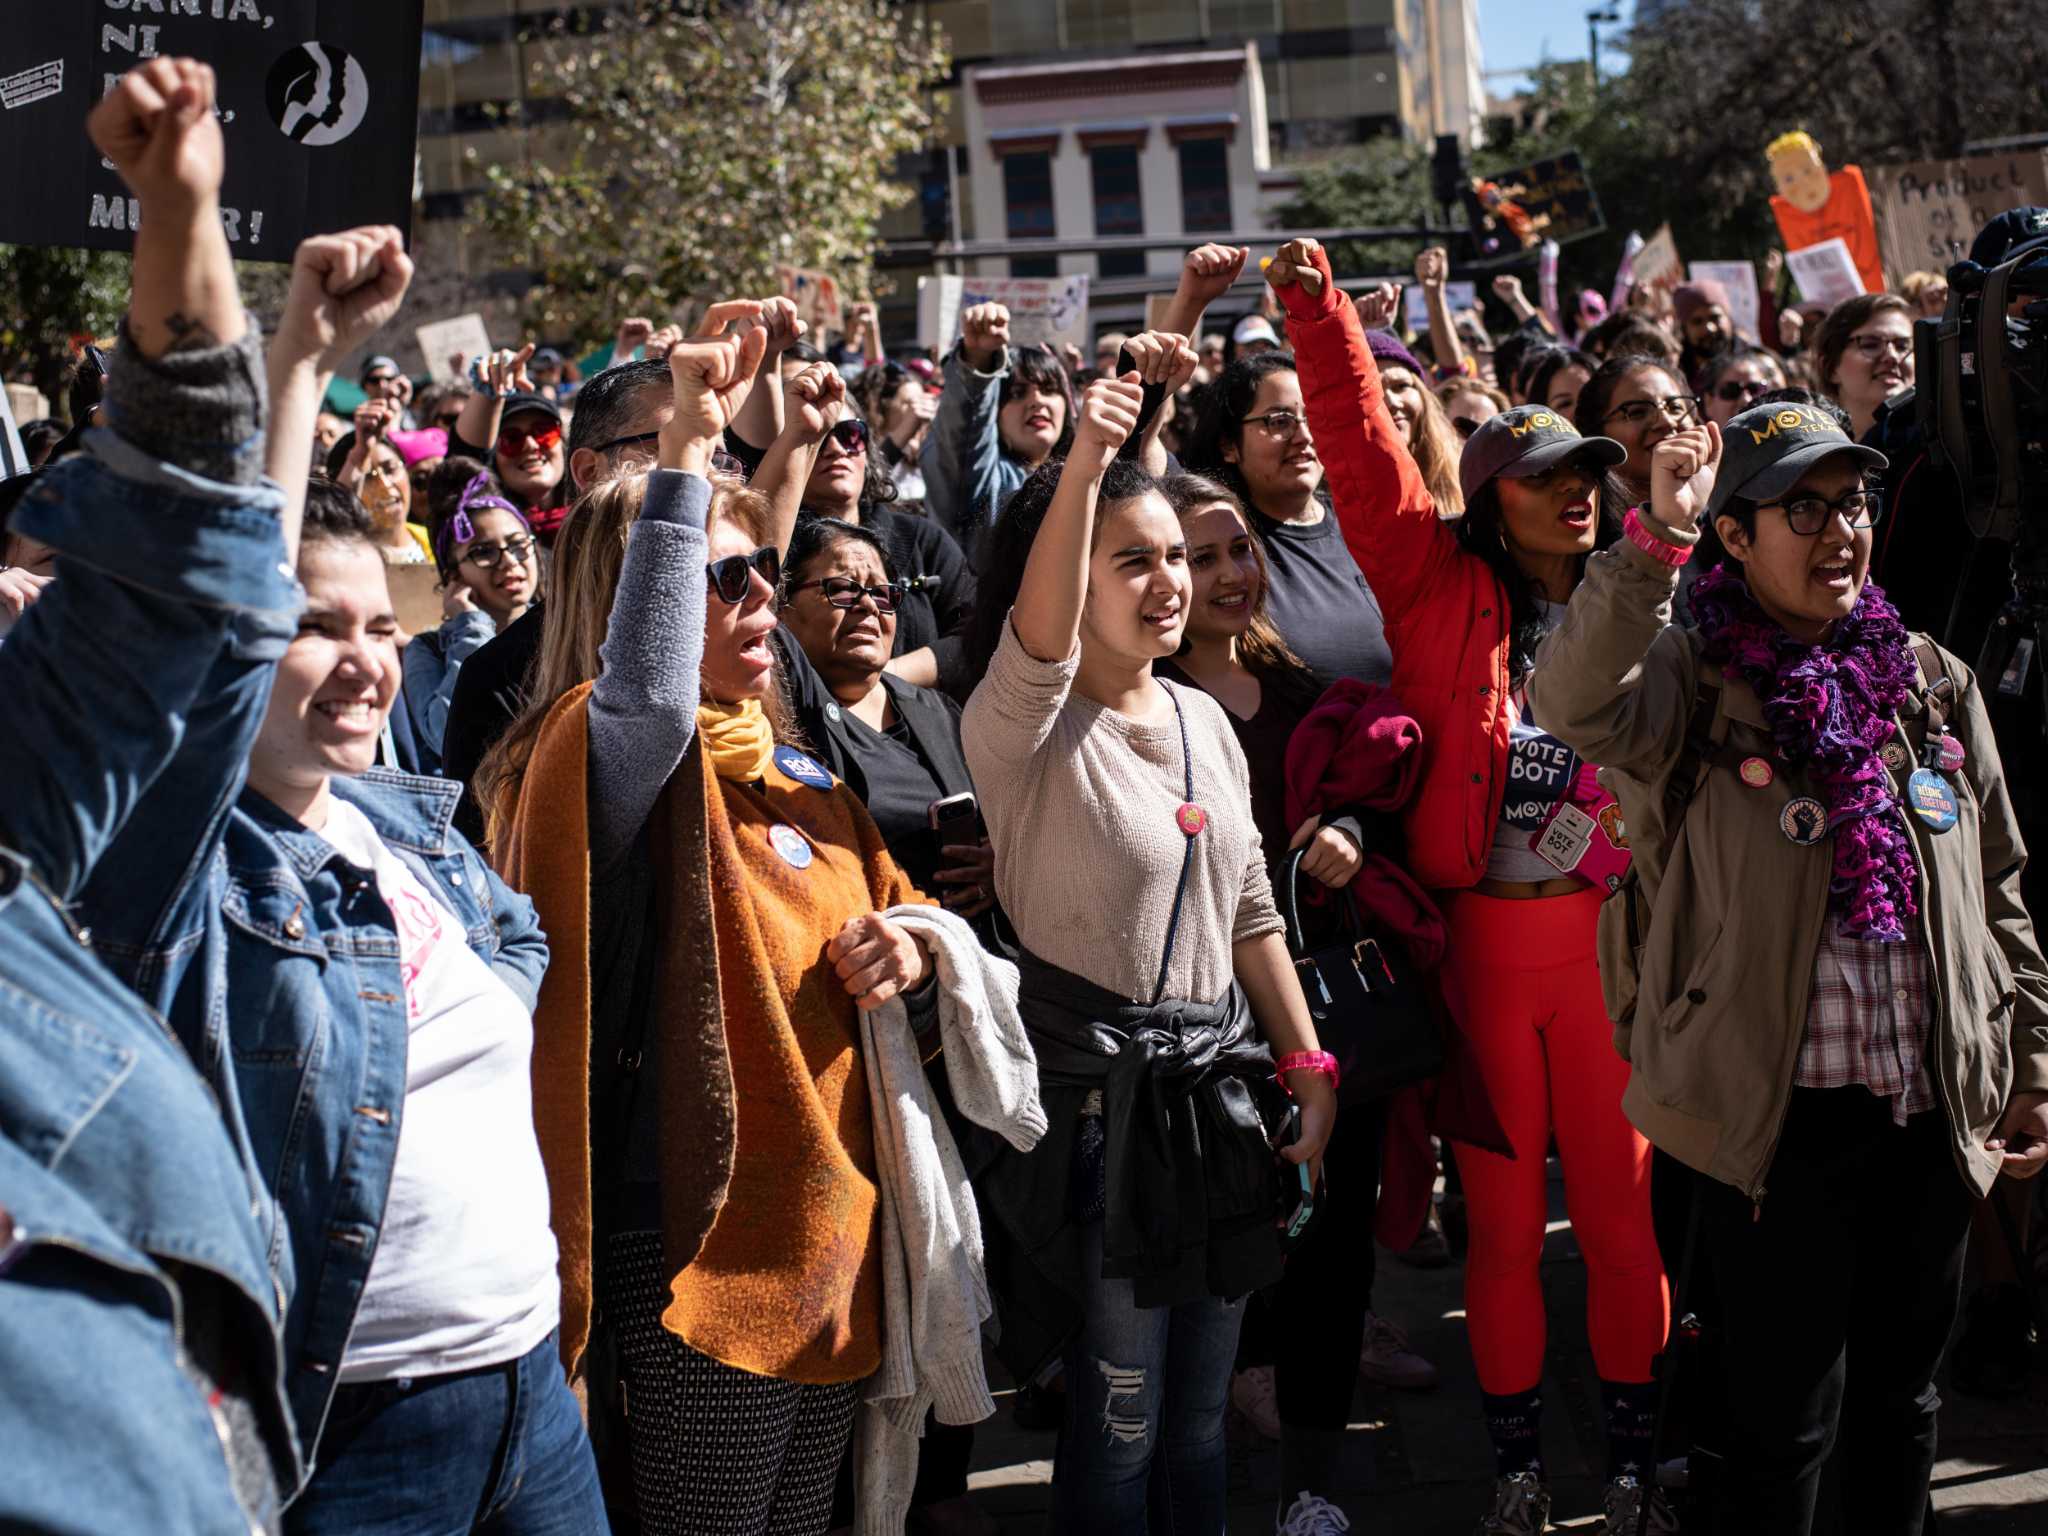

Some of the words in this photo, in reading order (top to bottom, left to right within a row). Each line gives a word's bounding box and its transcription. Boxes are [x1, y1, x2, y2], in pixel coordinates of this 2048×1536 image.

[104, 0, 274, 28] NTA,
[102, 23, 161, 58] NI
[1901, 161, 2025, 204] Product
[1507, 411, 1572, 439] MOV
[1750, 407, 1837, 446] MOVE
[1515, 740, 1568, 766] VOTE
[1510, 756, 1560, 786] BOT
[1505, 801, 1556, 820] MOV
[1547, 836, 1568, 855] BOT
[1552, 828, 1575, 849] VOTE
